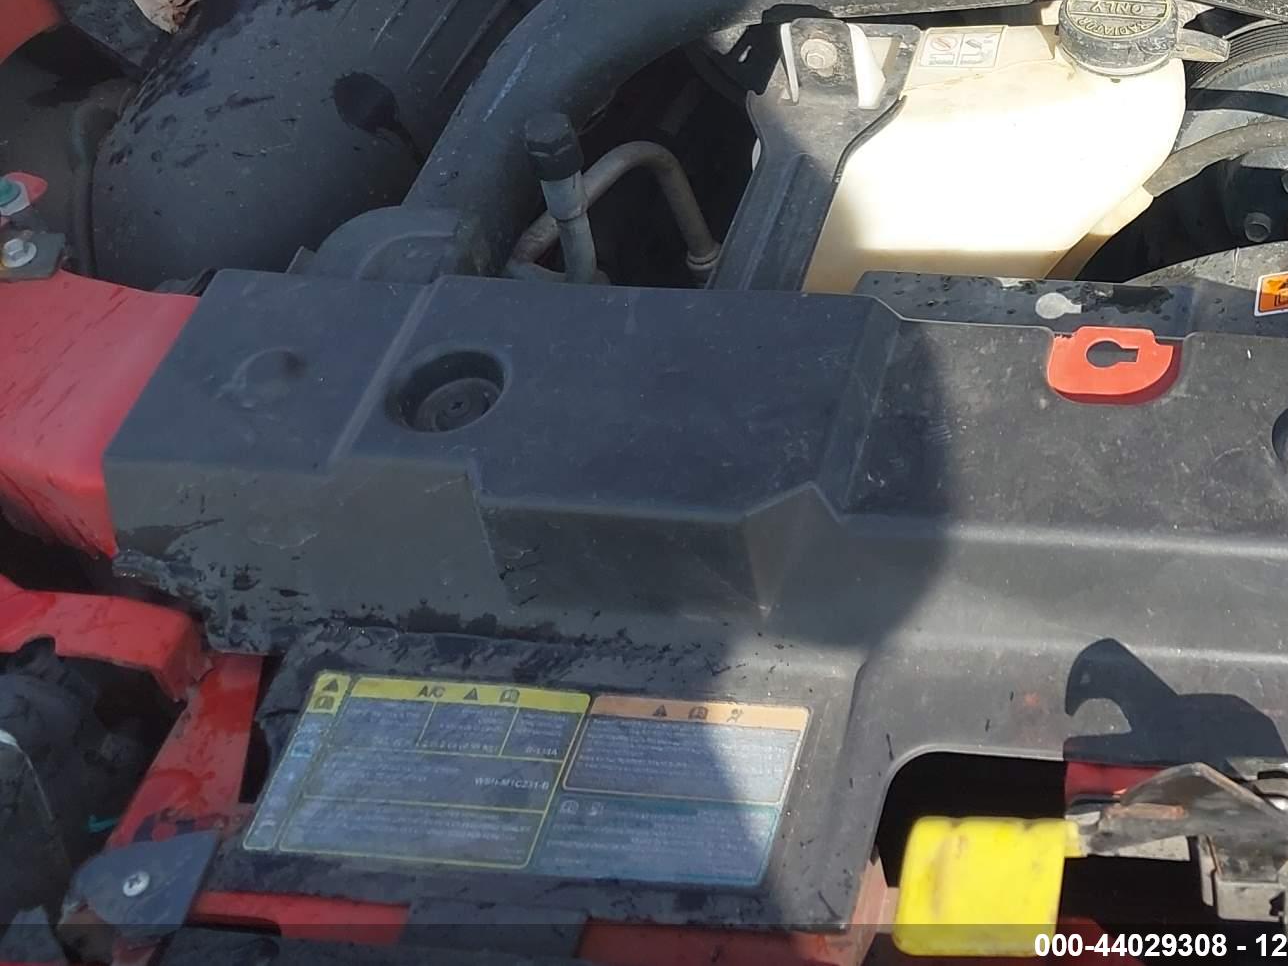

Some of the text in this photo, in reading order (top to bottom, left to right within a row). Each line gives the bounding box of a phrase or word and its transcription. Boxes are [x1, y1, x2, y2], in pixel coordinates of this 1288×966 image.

[1090, 2, 1144, 15] ONLY
[1077, 17, 1150, 36] RADIATOR
[416, 684, 446, 699] A/C
